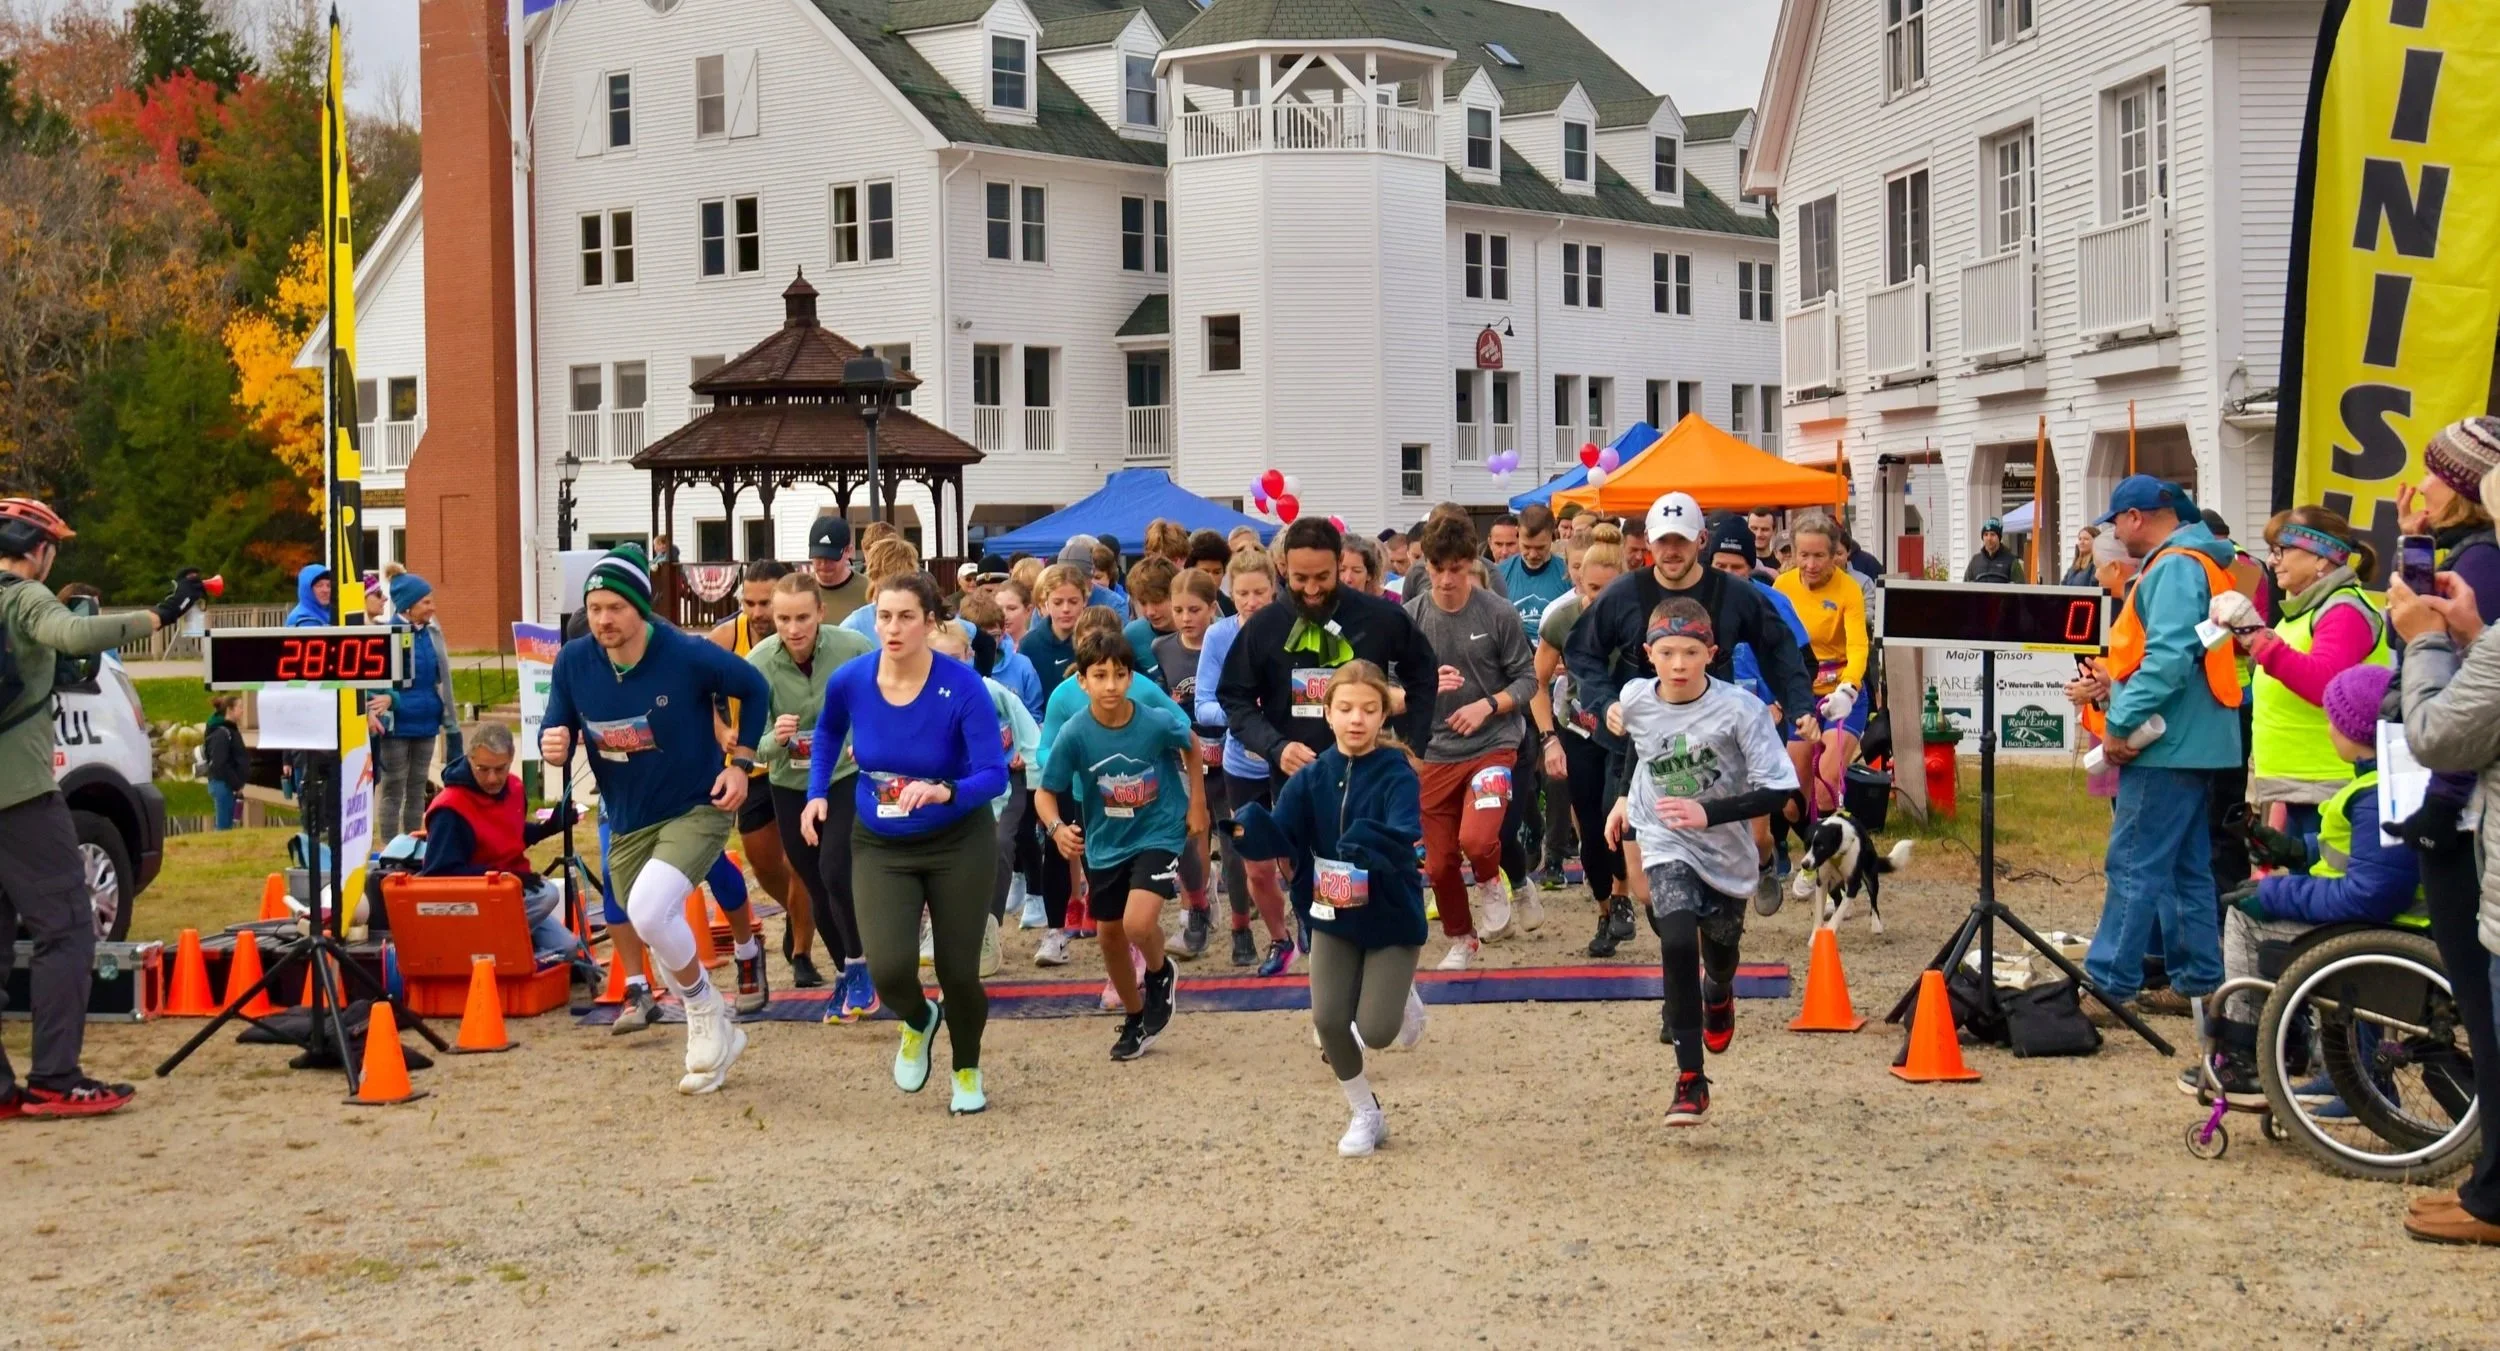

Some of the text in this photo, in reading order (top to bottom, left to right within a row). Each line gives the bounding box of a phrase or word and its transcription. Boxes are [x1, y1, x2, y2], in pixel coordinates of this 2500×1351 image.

[2322, 0, 2450, 593] INISH
[2065, 600, 2095, 640] 0
[277, 638, 386, 679] 28:05
[1946, 650, 2033, 661] Major onsors
[1923, 676, 1971, 690] PEARE
[525, 716, 541, 724] WATER
[2008, 717, 2058, 726] Real Estate
[2021, 709, 2044, 719] Roper
[56, 711, 102, 745] UL
[1114, 780, 1145, 803] 667
[1320, 871, 1352, 901] 626
